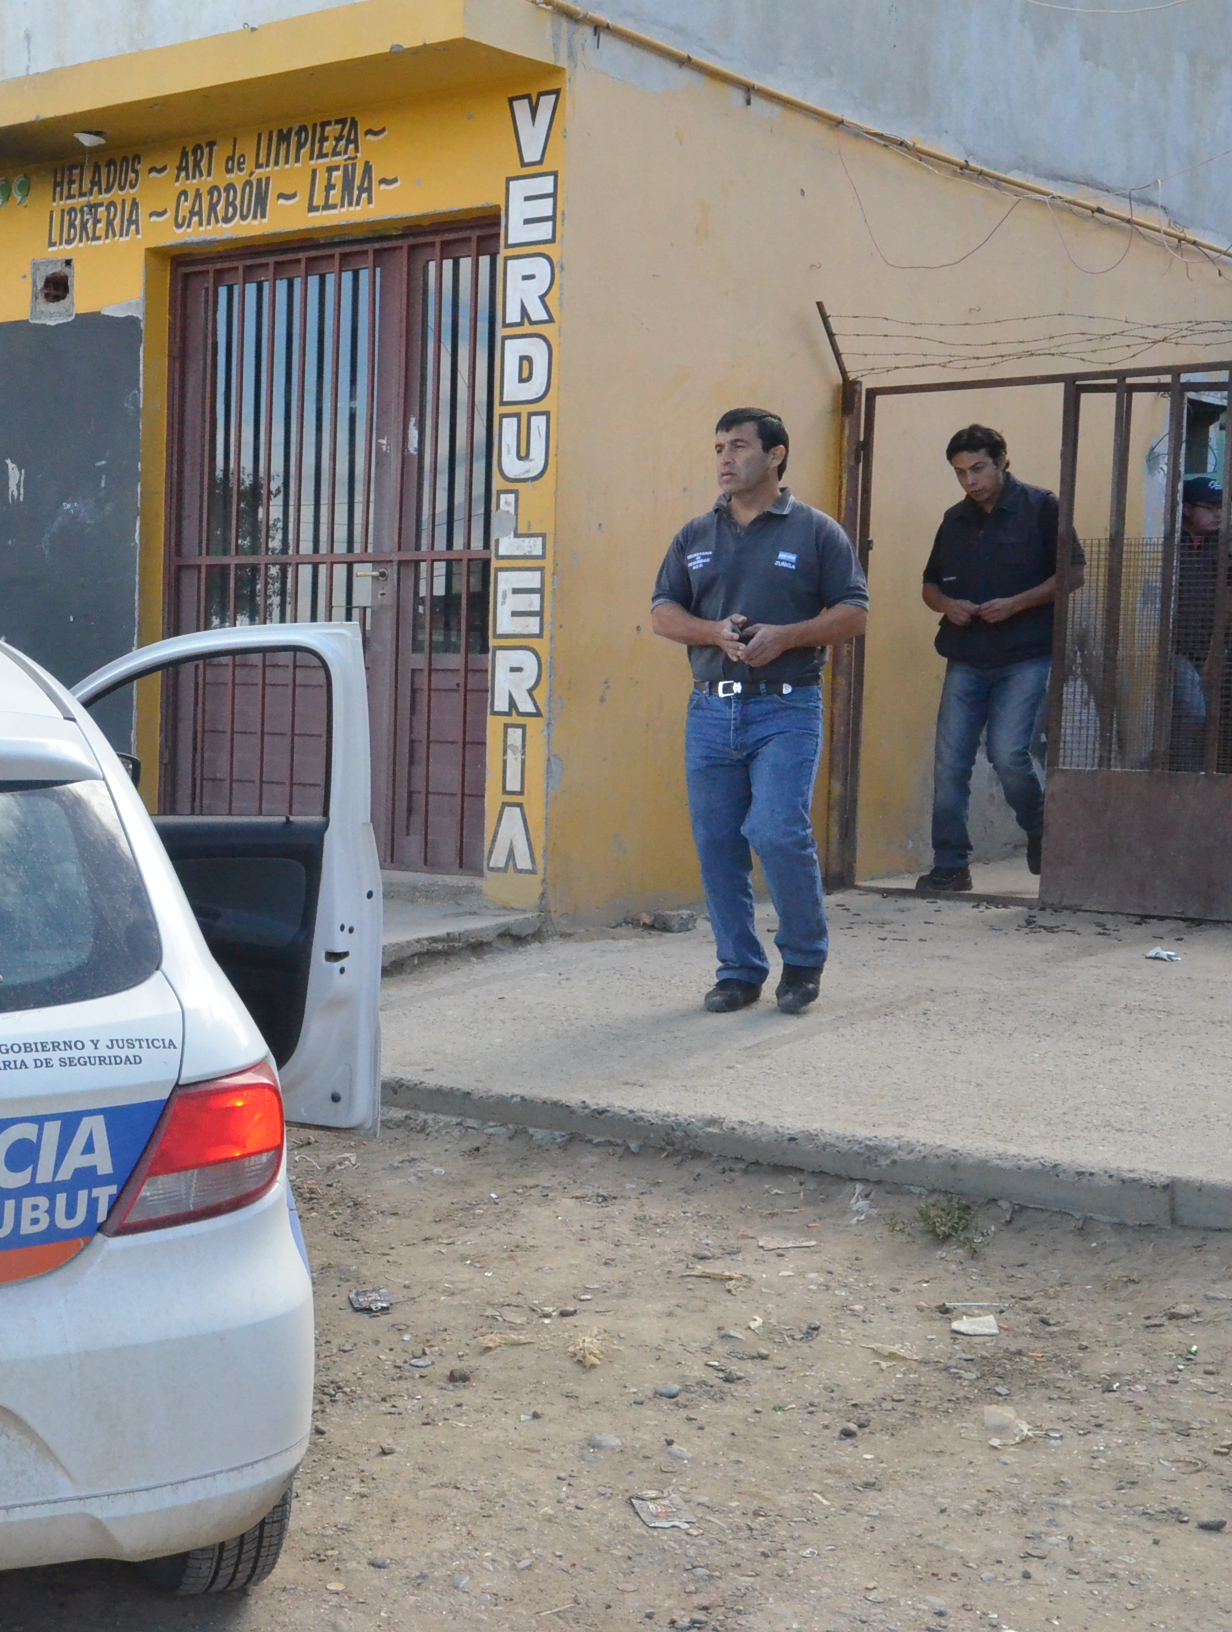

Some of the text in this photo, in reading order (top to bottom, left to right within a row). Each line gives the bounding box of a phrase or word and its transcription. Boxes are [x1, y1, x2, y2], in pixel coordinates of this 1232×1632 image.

[47, 153, 375, 251] LIBRERIA CARBÓN LEÑA
[52, 116, 361, 206] HELADOS ART de LIMPIEZA
[486, 88, 561, 875] VERDULERIA
[33, 1057, 54, 1069] DE
[58, 1054, 143, 1068] SEGURIDAD
[89, 1039, 100, 1050] Y
[106, 1038, 177, 1050] JUSTICIA
